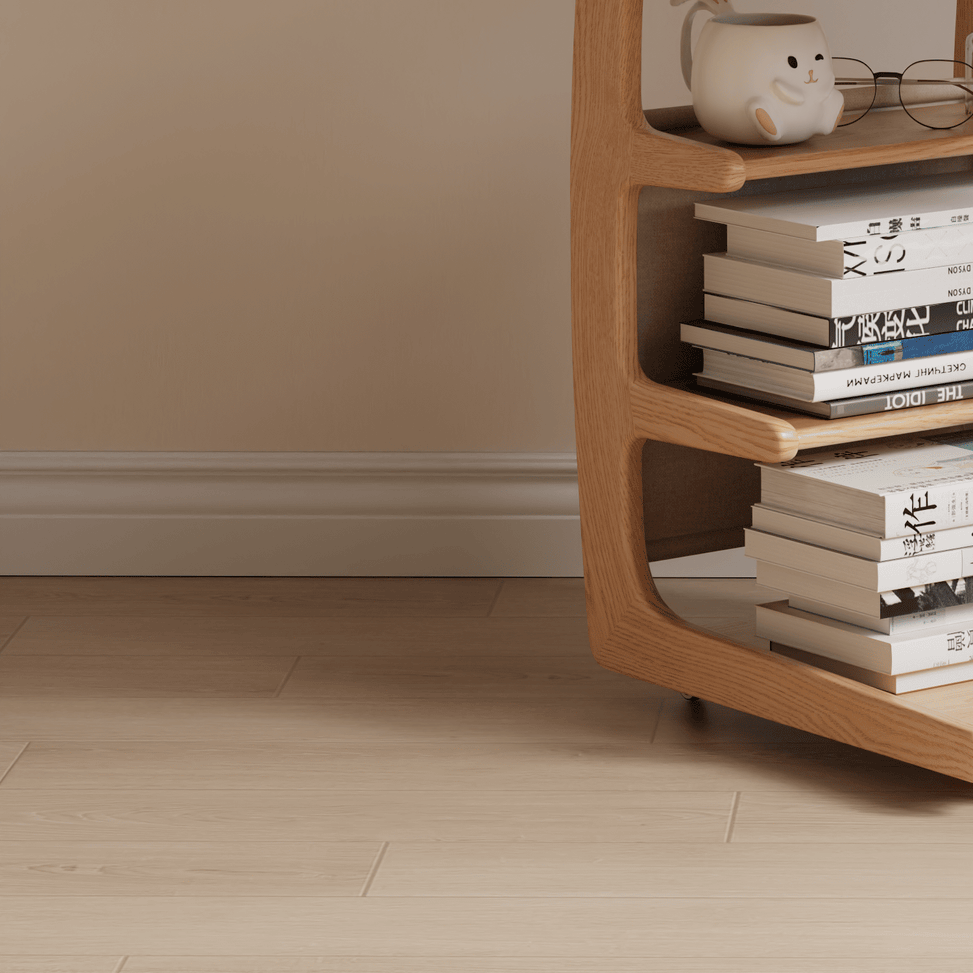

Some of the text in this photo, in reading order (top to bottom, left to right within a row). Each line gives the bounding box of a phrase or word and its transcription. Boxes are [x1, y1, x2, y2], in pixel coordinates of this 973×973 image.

[948, 265, 971, 275] DYSON
[947, 287, 971, 297] DYSON
[846, 363, 967, 388] СКЕТЧИНГ МАРКЕРАМИ
[884, 385, 964, 410] THE IDIOT
